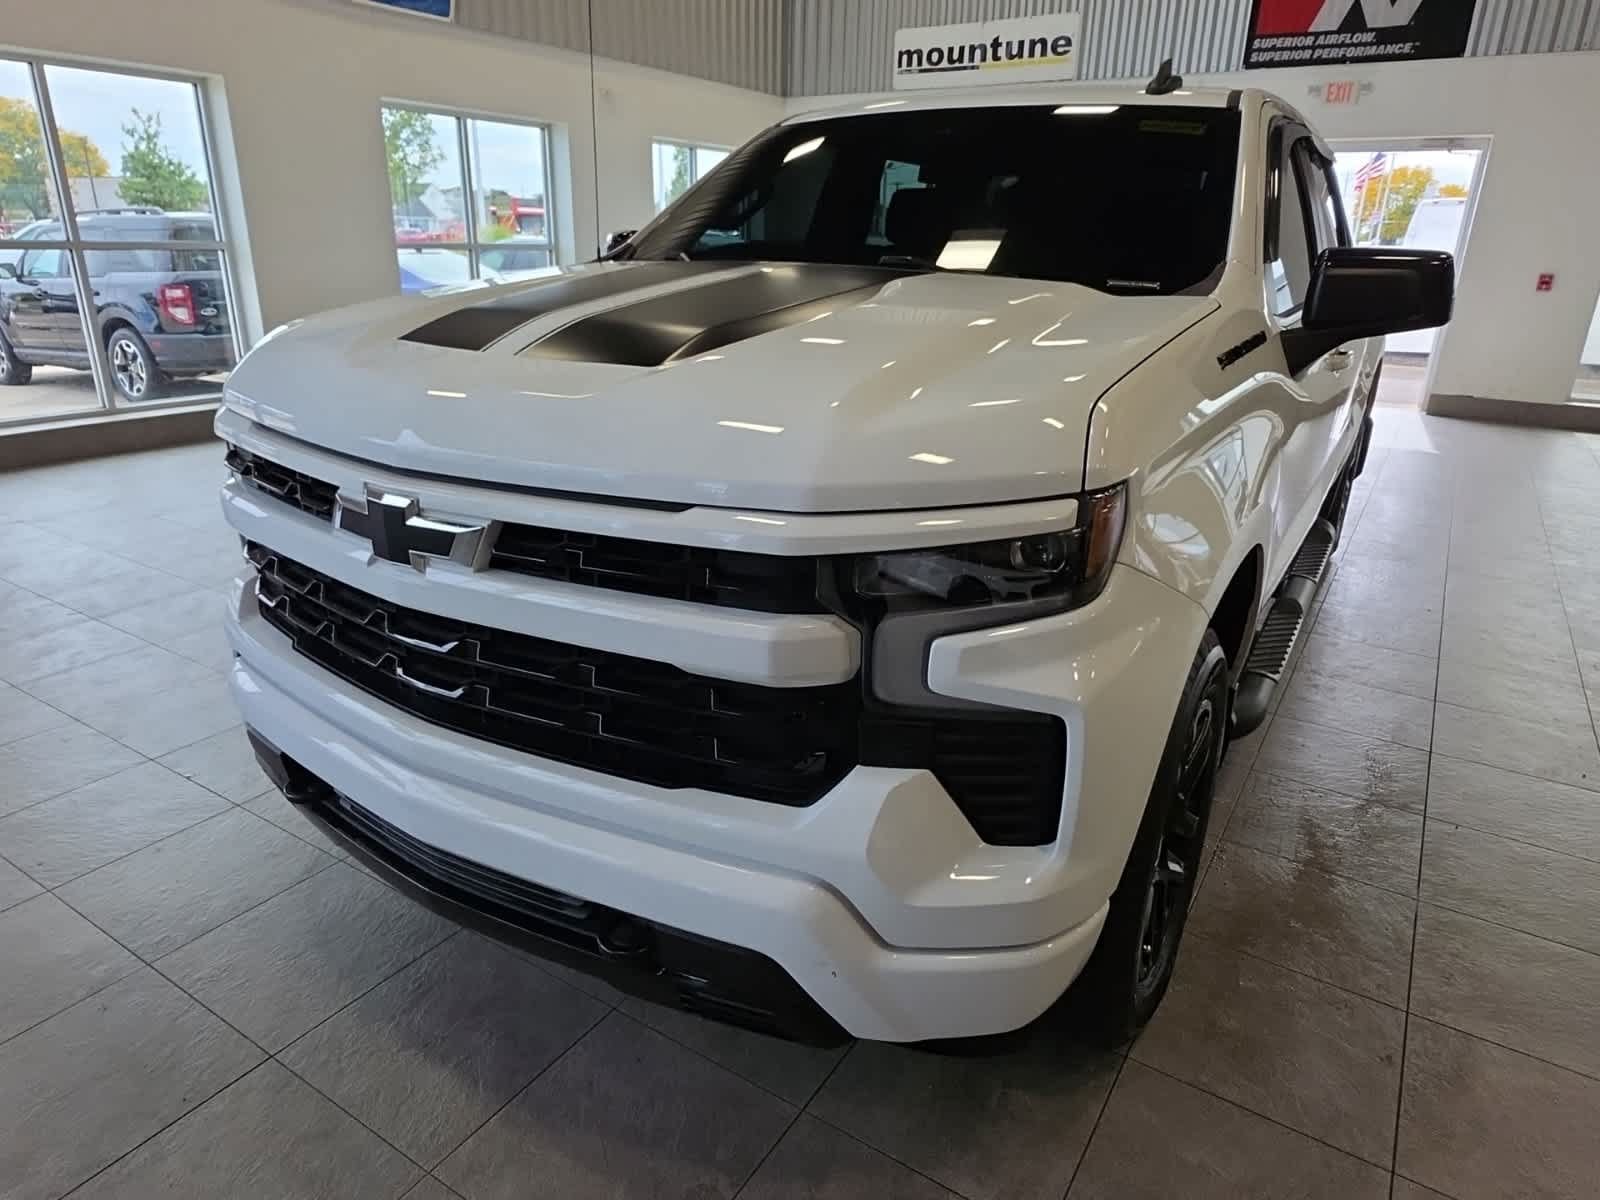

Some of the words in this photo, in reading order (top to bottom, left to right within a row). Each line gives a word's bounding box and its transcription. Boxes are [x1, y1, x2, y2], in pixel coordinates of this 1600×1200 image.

[1252, 36, 1316, 49] SUPERIOR
[1315, 32, 1377, 46] AIRFLOW.
[897, 35, 1073, 69] mountune
[1249, 49, 1313, 62] SUPERIOR
[1326, 82, 1354, 103] EXIT
